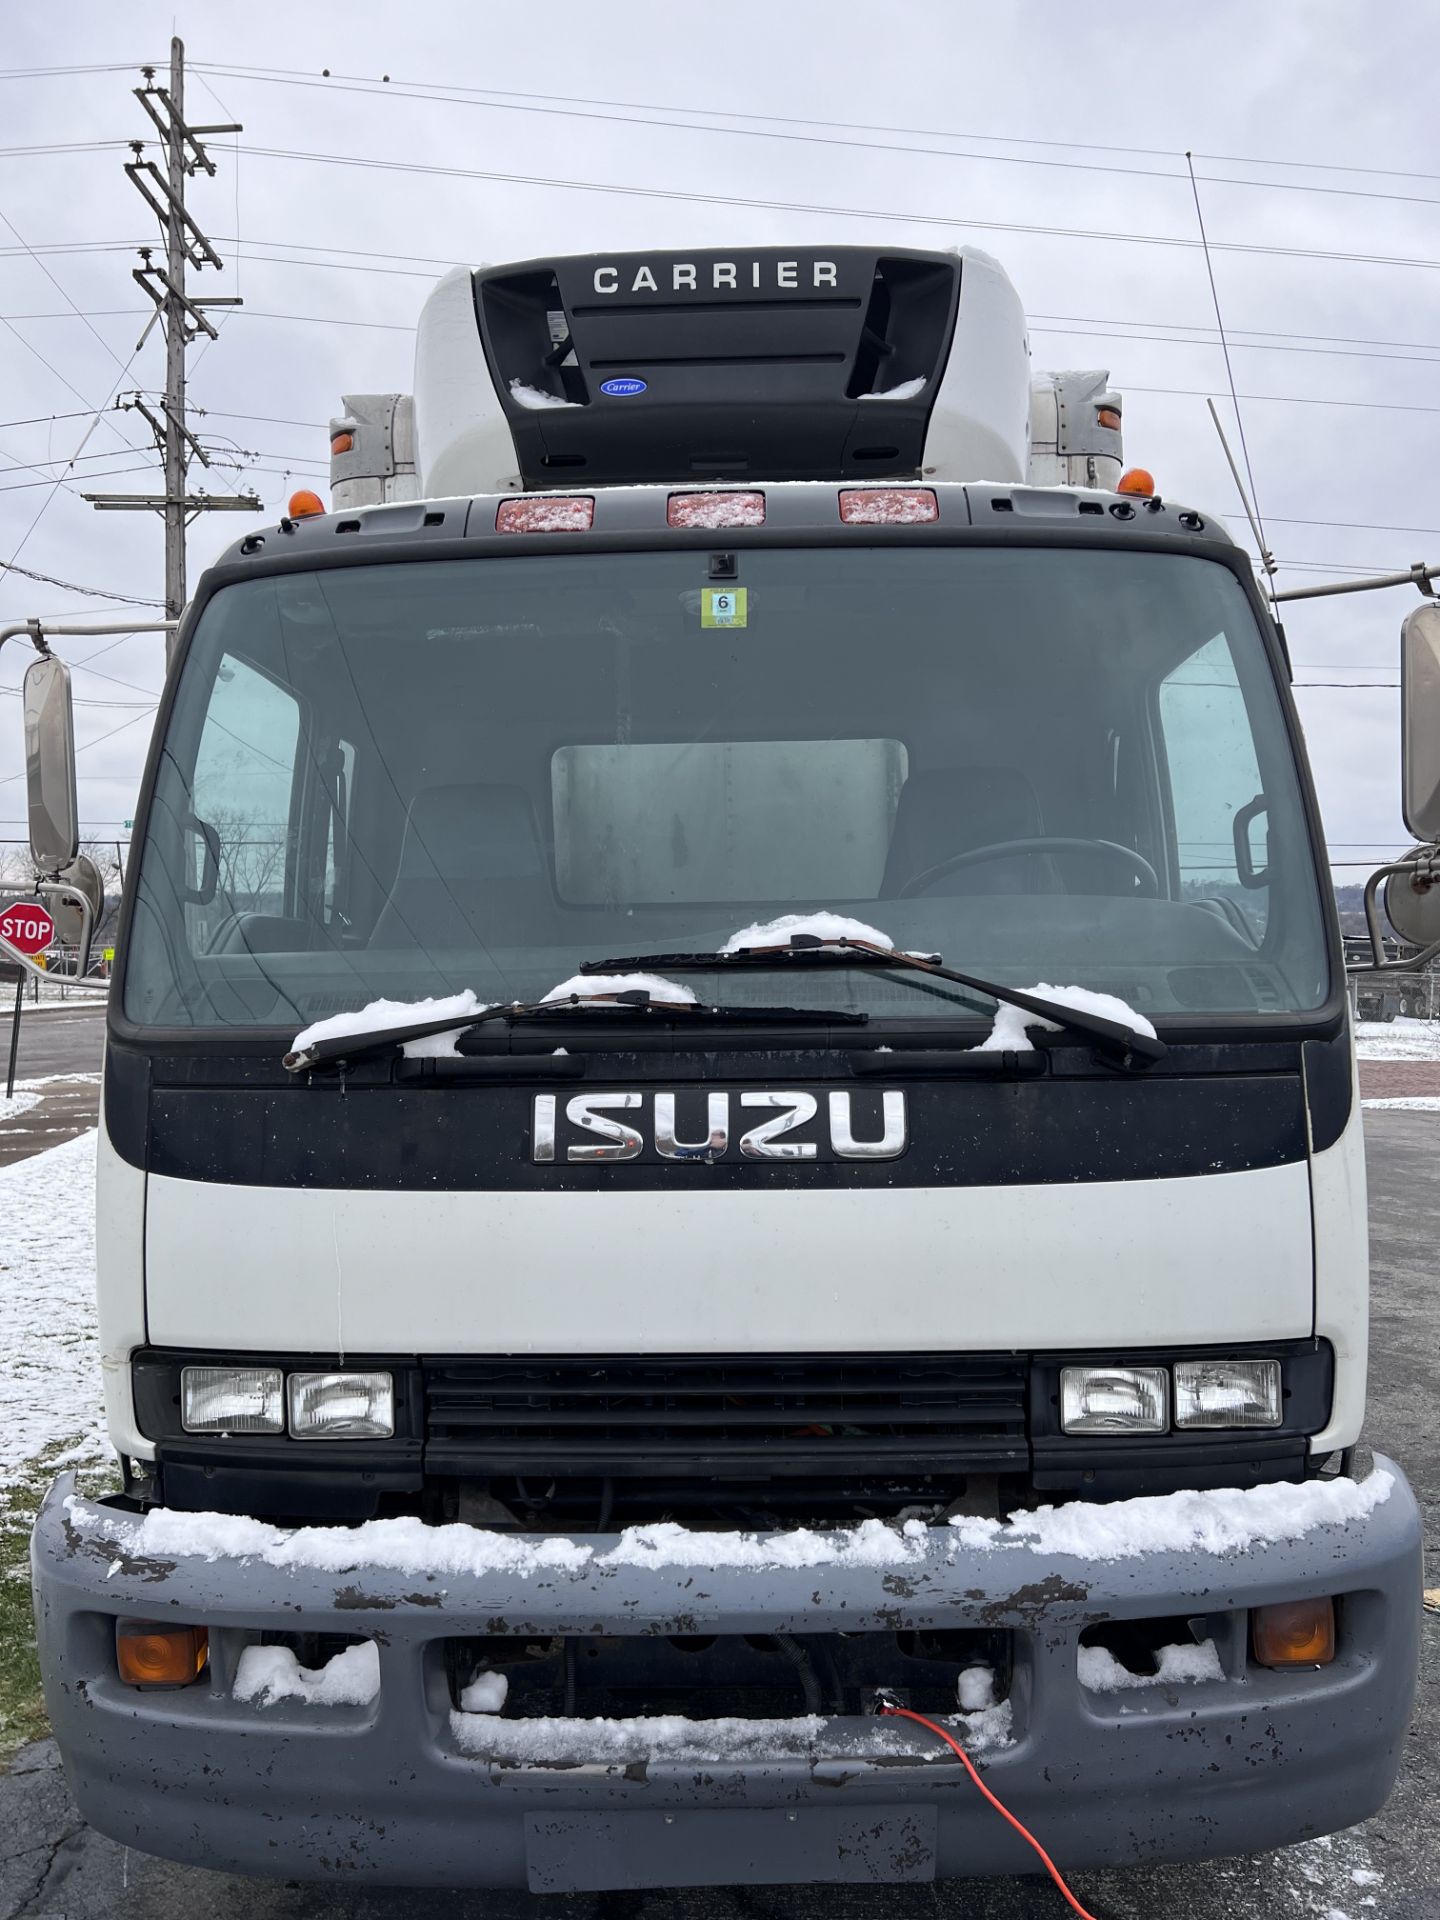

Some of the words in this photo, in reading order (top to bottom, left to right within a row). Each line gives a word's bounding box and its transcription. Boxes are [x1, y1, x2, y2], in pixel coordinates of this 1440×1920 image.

[593, 261, 837, 293] CARRIER
[606, 382, 641, 392] Carrier
[718, 595, 729, 609] 6
[1, 918, 51, 940] STOP
[533, 1091, 905, 1161] ISUZU
